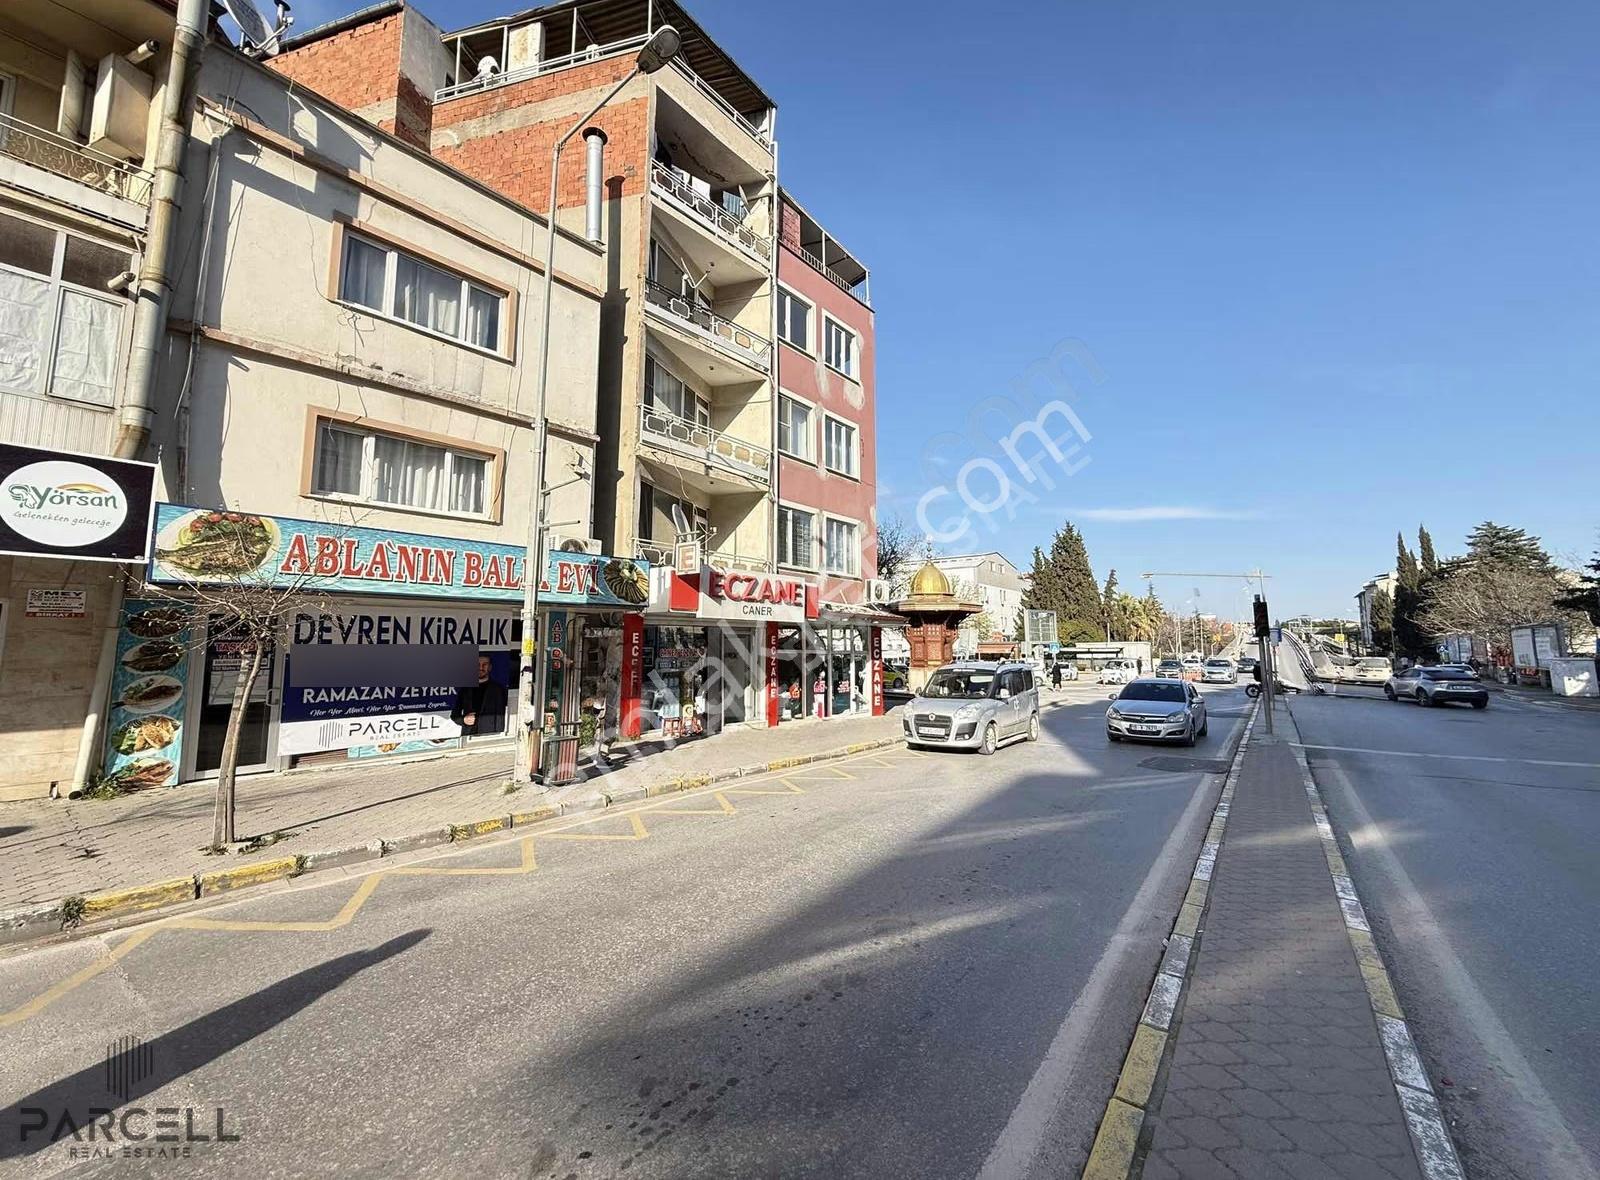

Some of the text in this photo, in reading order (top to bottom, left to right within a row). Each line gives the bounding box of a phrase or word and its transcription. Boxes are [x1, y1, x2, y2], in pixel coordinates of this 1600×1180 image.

[31, 486, 118, 509] Yörsan
[557, 557, 599, 595] EVİ
[709, 571, 804, 607] ECZANE
[742, 605, 773, 617] CANER
[294, 614, 411, 645] DEVREN
[769, 636, 777, 699] ECZANE
[871, 637, 881, 707] ECZANE
[302, 686, 400, 704] RAMAZAN
[348, 717, 440, 737] PARCELL
